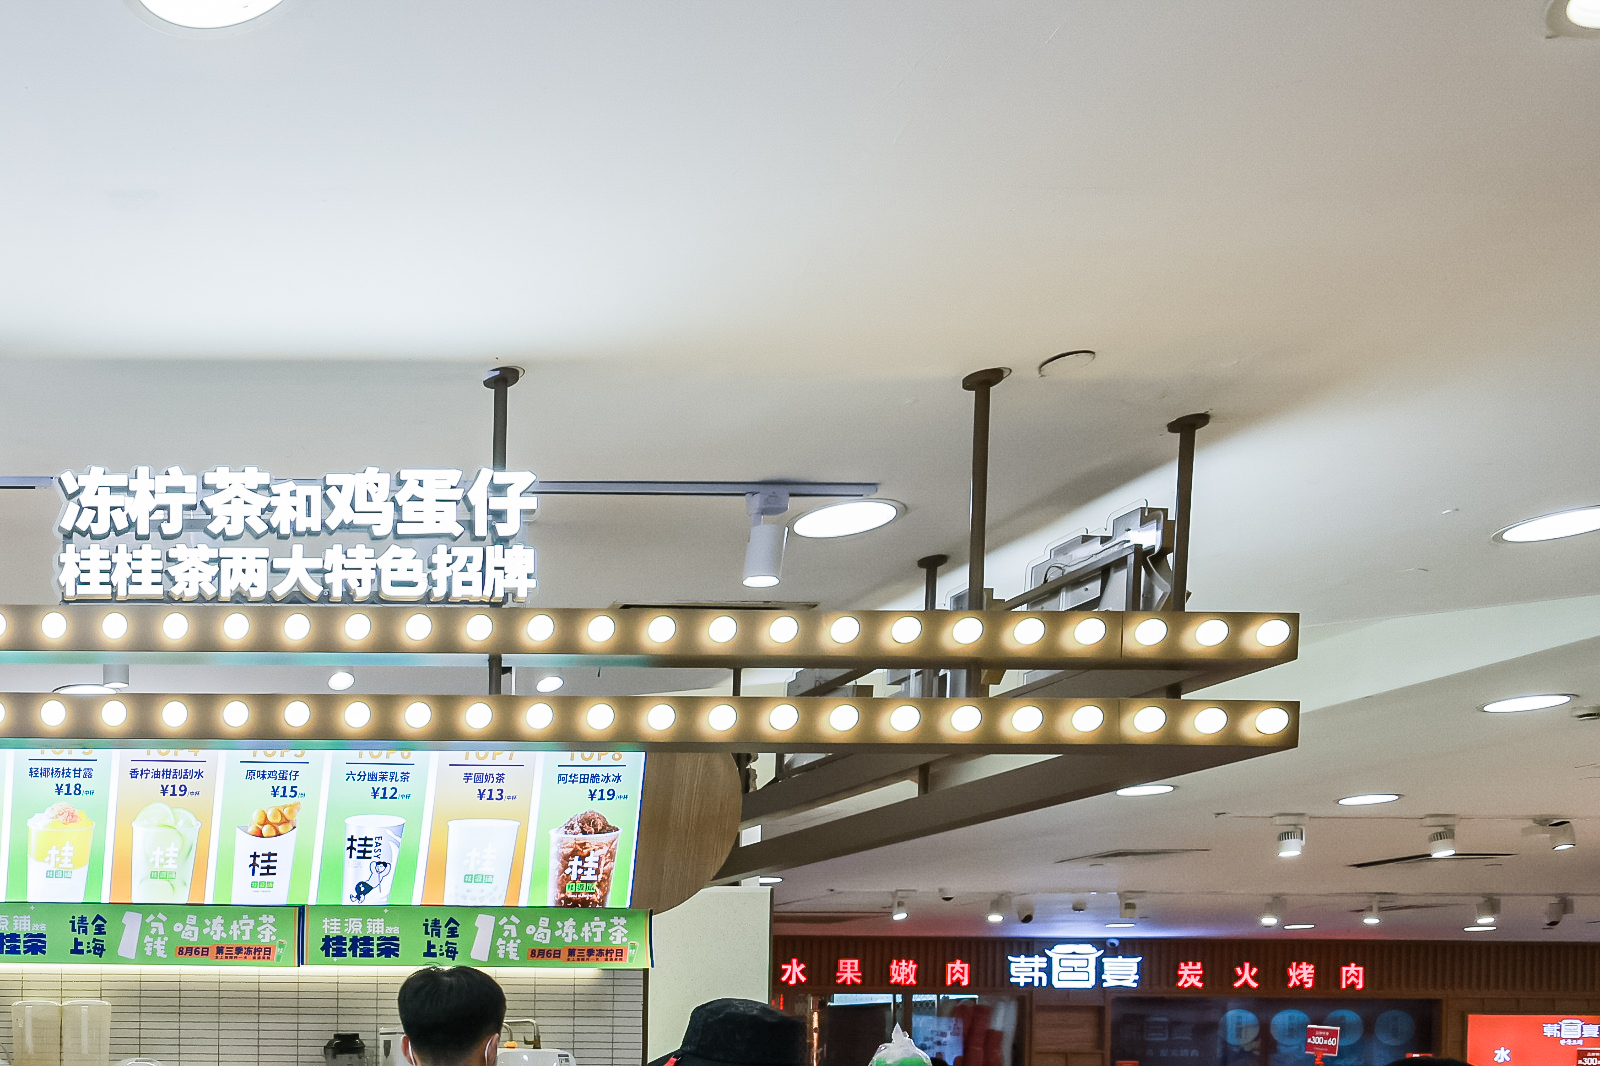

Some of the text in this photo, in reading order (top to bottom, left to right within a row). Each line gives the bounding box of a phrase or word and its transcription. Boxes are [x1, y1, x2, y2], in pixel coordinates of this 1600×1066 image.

[57, 465, 539, 538] 冻柠茶和鸡蛋仔
[58, 543, 537, 602] 桂桂茶两大特色招牌
[28, 767, 94, 779] 轻椰杨枝甘露
[129, 767, 204, 780] 香柠油柑刮刮水
[245, 769, 300, 782] 原味鸡蛋仔
[462, 772, 506, 784] 芋圆奶茶
[557, 772, 622, 785] 阿华田脆冰冰
[44, 841, 74, 869] 桂
[346, 835, 374, 860] 桂
[374, 835, 383, 860] EASY
[249, 851, 278, 877] 桂
[564, 850, 600, 882] 桂
[69, 913, 108, 936] 请全
[173, 914, 277, 943] 喝冻柠茶
[422, 917, 461, 939] 请全
[525, 916, 629, 945] 喝冻柠茶
[69, 937, 107, 959] 上海
[177, 946, 210, 957] 8月6日
[215, 945, 272, 957] 第三季冻柠日
[422, 940, 459, 961] 上海
[530, 949, 562, 959] 8月6日
[567, 947, 625, 958] 第三季冻柠日
[780, 957, 971, 987] 水果嫩肉
[1007, 942, 1143, 989] 韩宫宴
[1176, 961, 1365, 989] 炭火烤肉
